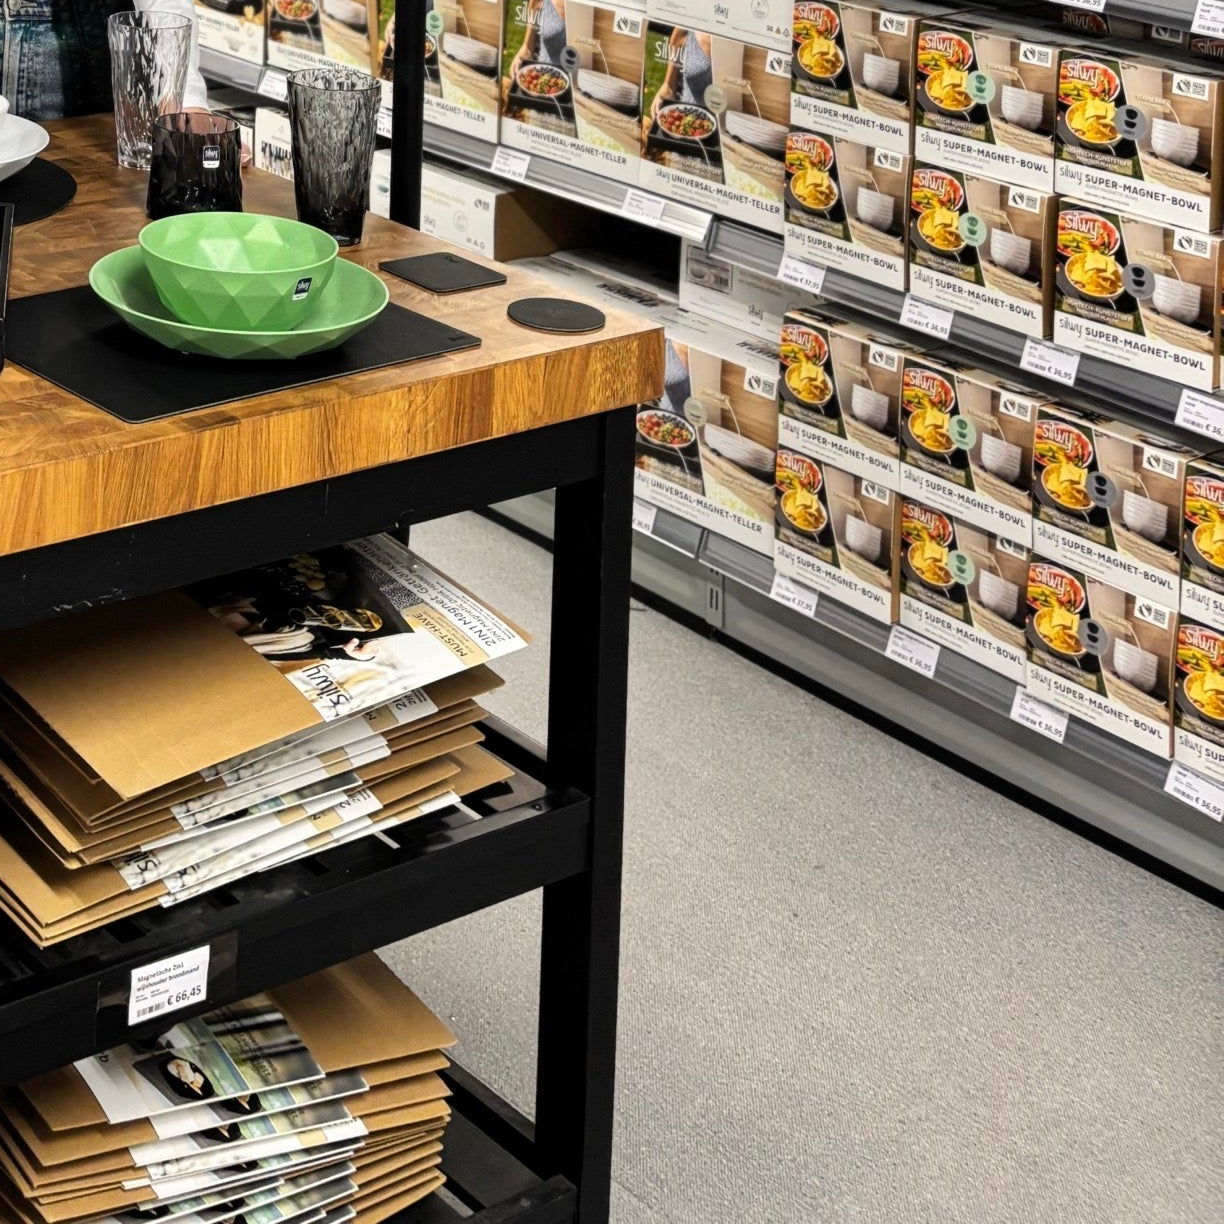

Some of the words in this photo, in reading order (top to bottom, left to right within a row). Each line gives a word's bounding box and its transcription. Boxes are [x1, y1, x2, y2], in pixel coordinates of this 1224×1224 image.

[798, 3, 824, 33] silwy
[926, 33, 955, 63] silwy
[1067, 60, 1102, 89] silwy
[813, 104, 904, 137] SUPER-MAGNET-BOWL
[530, 130, 627, 165] UNIVERSAL-MAGNET-TELLER
[792, 135, 818, 159] silwy
[921, 132, 941, 152] silwy
[943, 141, 1048, 175] SUPER-MAGNET-BOWL
[671, 174, 780, 215] UNIVERSAL-MAGNET-TELLER
[918, 173, 946, 197] silwy
[1060, 164, 1084, 186] silwy
[1085, 174, 1203, 213] SUPER-MAGNET-BOWL
[1065, 213, 1099, 242] silwy
[807, 235, 899, 273] SUPER-MAGNET-BOWL
[914, 269, 934, 289] silwy
[935, 278, 1037, 320] SUPER-MAGNET-BOWL
[786, 327, 812, 353] silwy
[1060, 317, 1083, 338] silwy
[1085, 327, 1206, 371] SUPER-MAGNET-BOWL
[910, 372, 938, 399] silwy
[1054, 368, 1072, 380] 36,95
[801, 429, 894, 473] SUPER-MAGNET-BOWL
[1042, 423, 1073, 452] silwy
[781, 451, 807, 480] silwy
[650, 480, 763, 534] UNIVERSAL-MAGNET-TELLER
[907, 504, 936, 531] silwy
[925, 479, 1026, 529] SUPER-MAGNET-BOWL
[1037, 526, 1060, 548] silwy
[1062, 537, 1174, 591] SUPER-MAGNET-BOWL
[796, 556, 886, 606] SUPER-MAGNET-BOWL
[1035, 567, 1066, 597] silwy
[1187, 588, 1211, 610] silwy
[413, 613, 468, 657] MUST-HAVE
[468, 626, 497, 647] 2IN1
[925, 611, 1023, 666] SUPER-MAGNET-BOWL
[1185, 629, 1218, 661] silwy
[302, 664, 349, 705] silwy
[1031, 668, 1052, 690] silwy
[1054, 681, 1163, 740] SUPER-MAGNET-BOWL
[1044, 723, 1063, 738] 36,95
[1179, 734, 1204, 758] silwy
[1201, 798, 1222, 816] 36,95
[137, 967, 171, 982] Magnetische
[167, 995, 174, 1005] €
[176, 985, 201, 1002] 66,45
